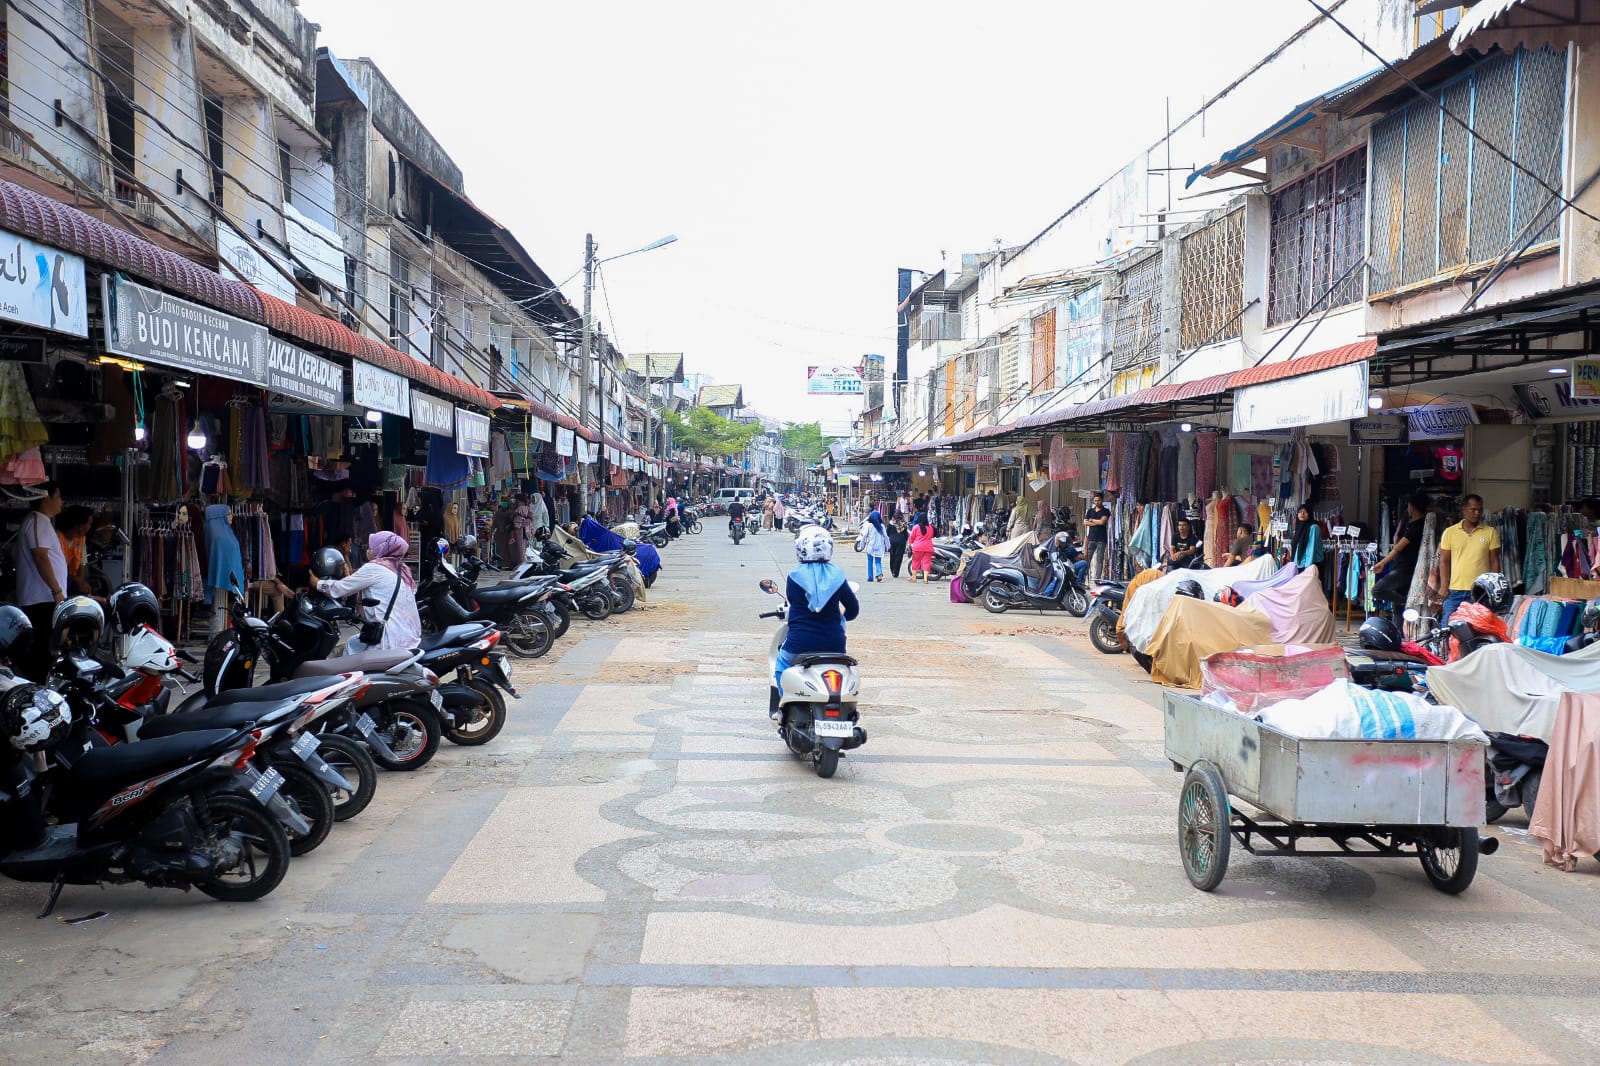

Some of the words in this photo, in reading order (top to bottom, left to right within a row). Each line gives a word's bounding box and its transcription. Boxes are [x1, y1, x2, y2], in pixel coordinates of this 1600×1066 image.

[164, 301, 180, 316] TOKO
[181, 308, 203, 324] GROSIR
[208, 316, 229, 331] ECERAN
[138, 311, 179, 350] BUDI
[184, 324, 250, 369] KENCANA
[298, 352, 342, 393] KERUDUNG
